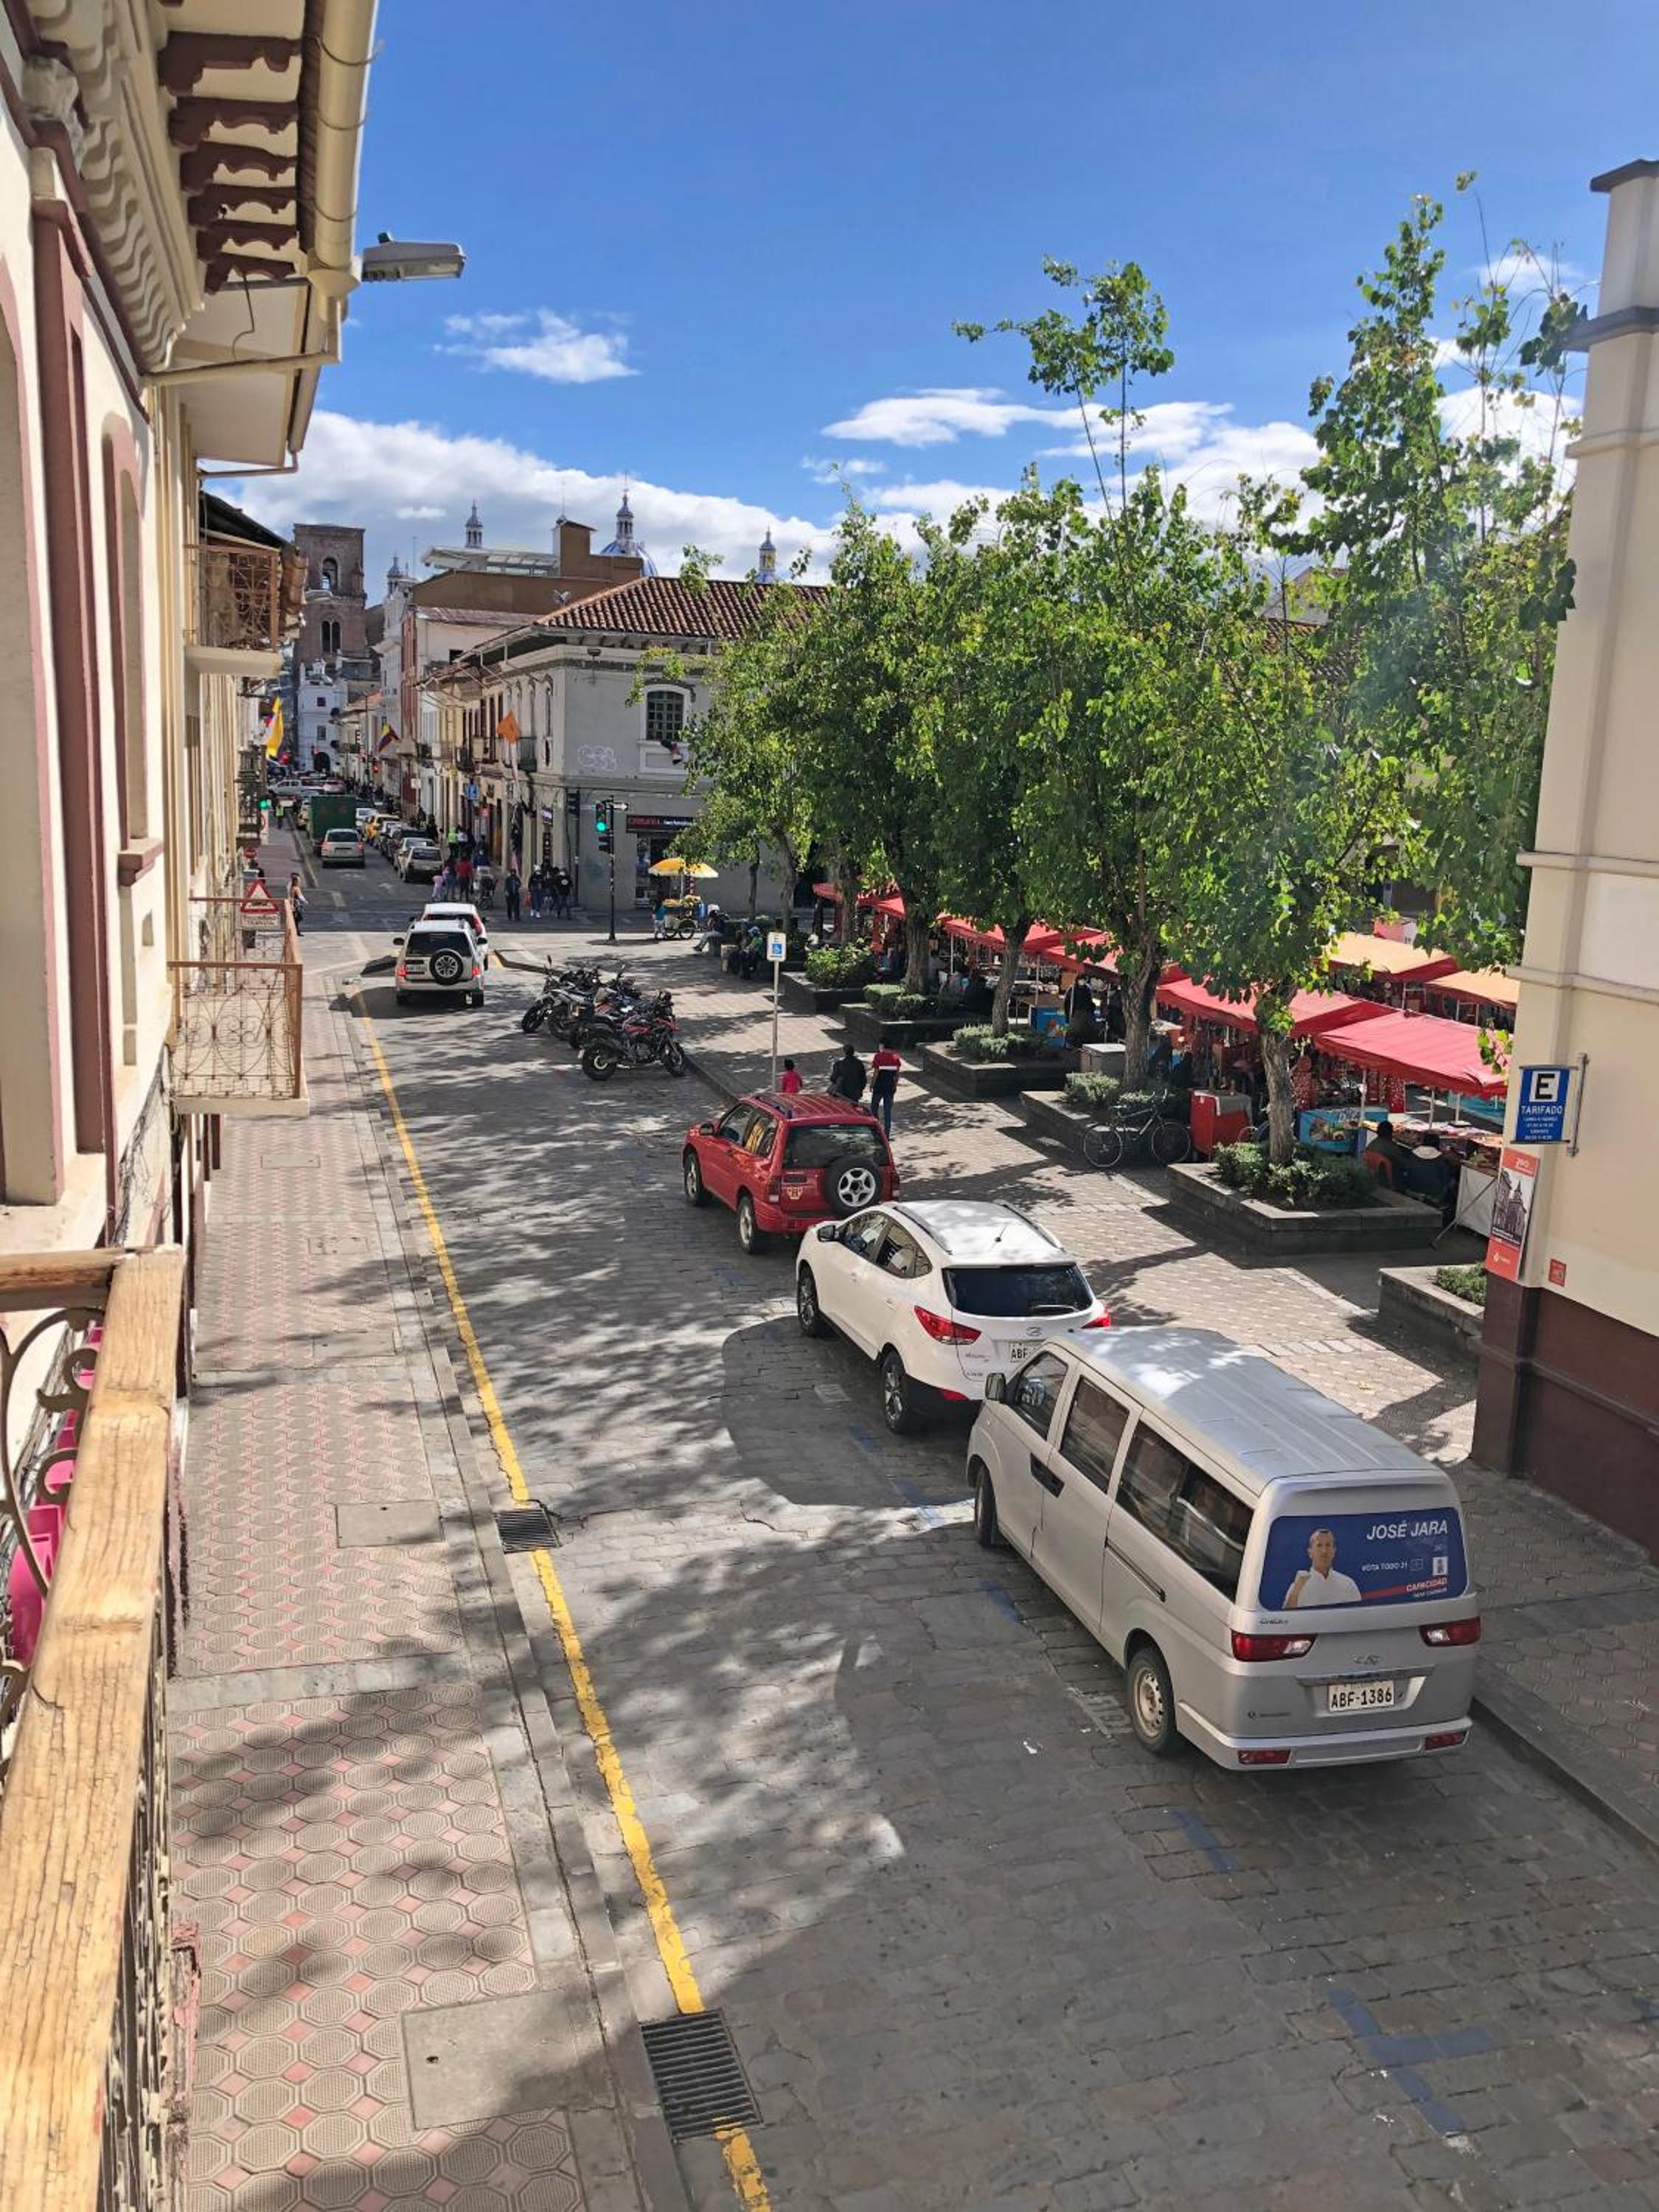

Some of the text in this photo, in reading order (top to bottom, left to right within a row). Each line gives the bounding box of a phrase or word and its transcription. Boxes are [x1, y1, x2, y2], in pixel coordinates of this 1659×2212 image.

[1535, 1073, 1556, 1099] E
[1521, 1106, 1562, 1115] TARIFADO
[1367, 1520, 1447, 1540] JOSÉ JARA
[1332, 1687, 1392, 1708] ABF-1386
